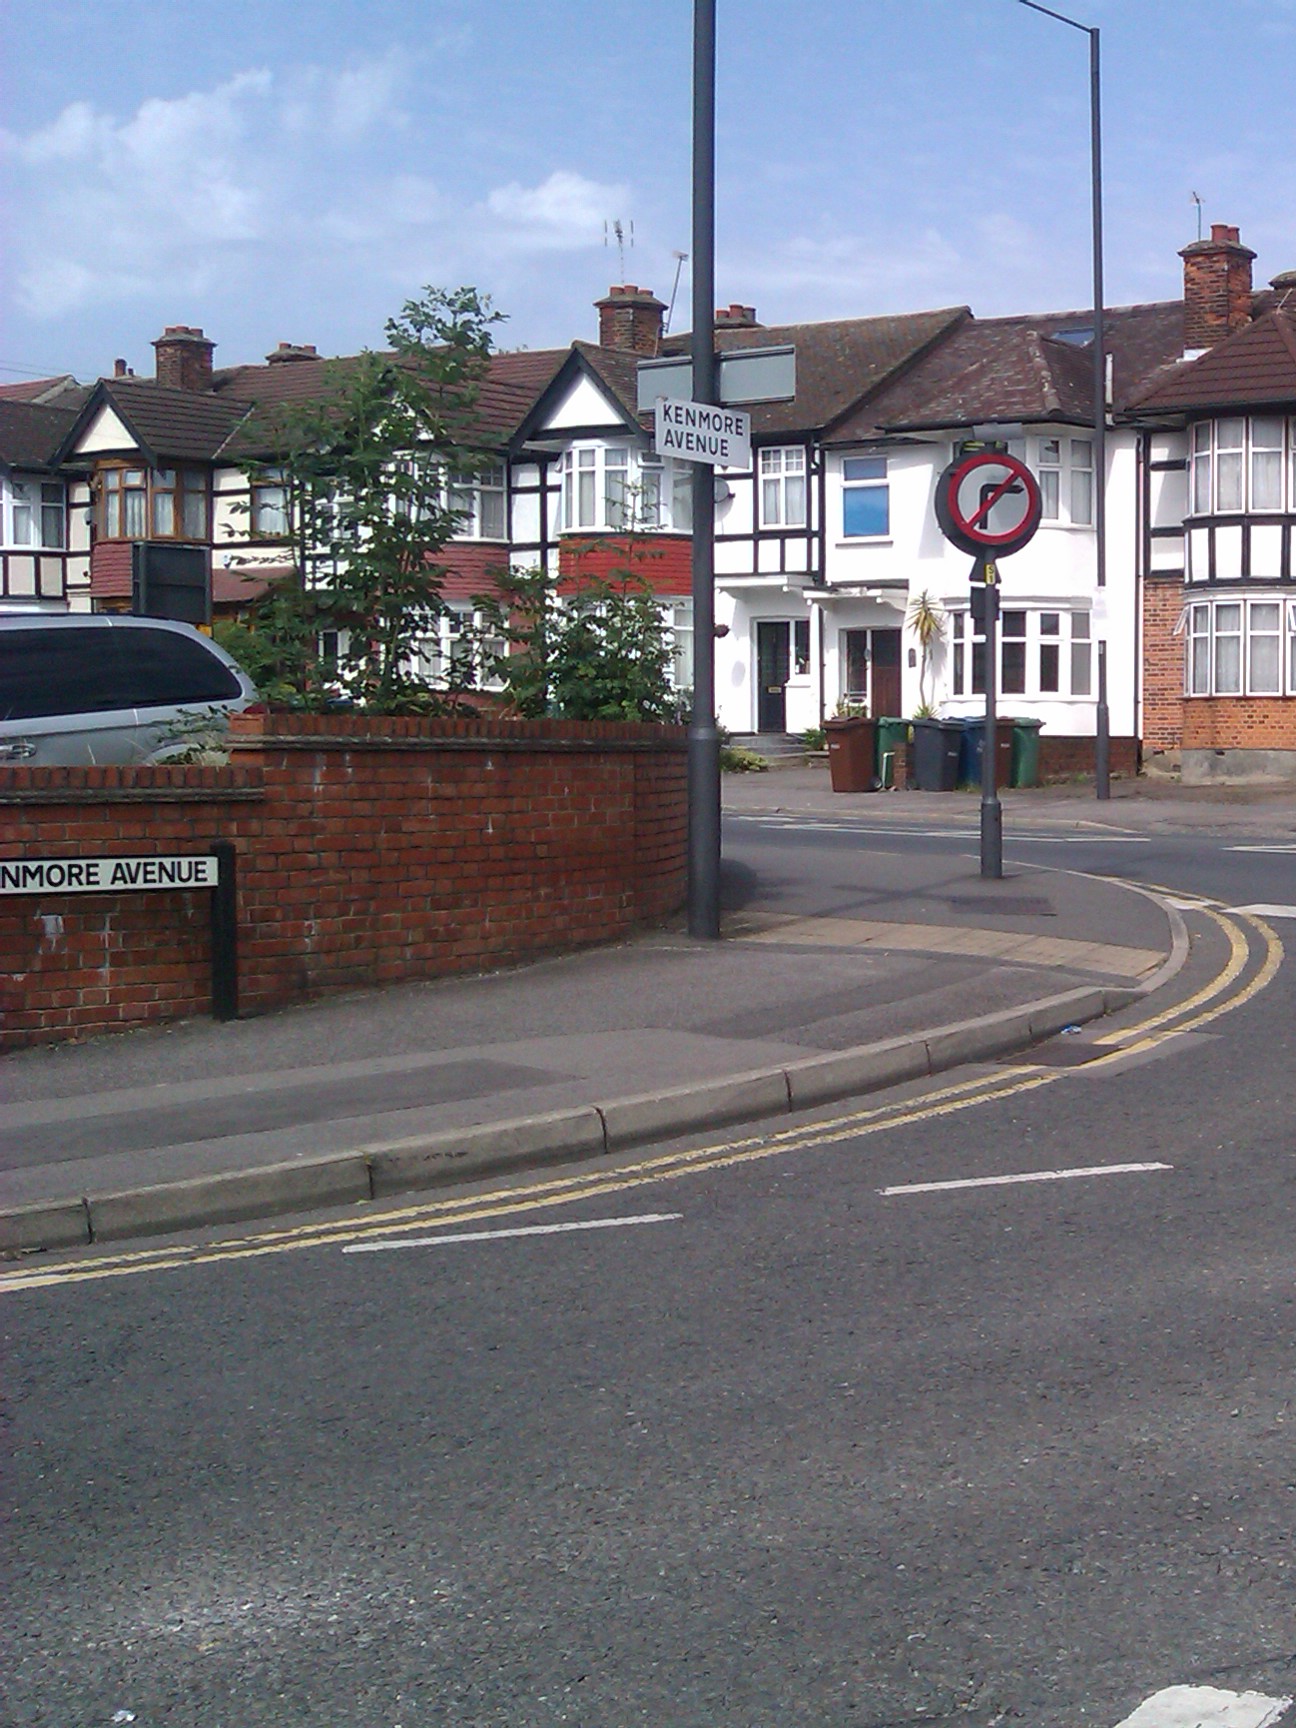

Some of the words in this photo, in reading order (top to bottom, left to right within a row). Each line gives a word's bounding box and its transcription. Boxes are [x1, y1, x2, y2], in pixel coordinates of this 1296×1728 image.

[663, 404, 744, 436] KENMORE
[664, 430, 729, 457] AVENUE
[110, 860, 208, 885] AVENUE
